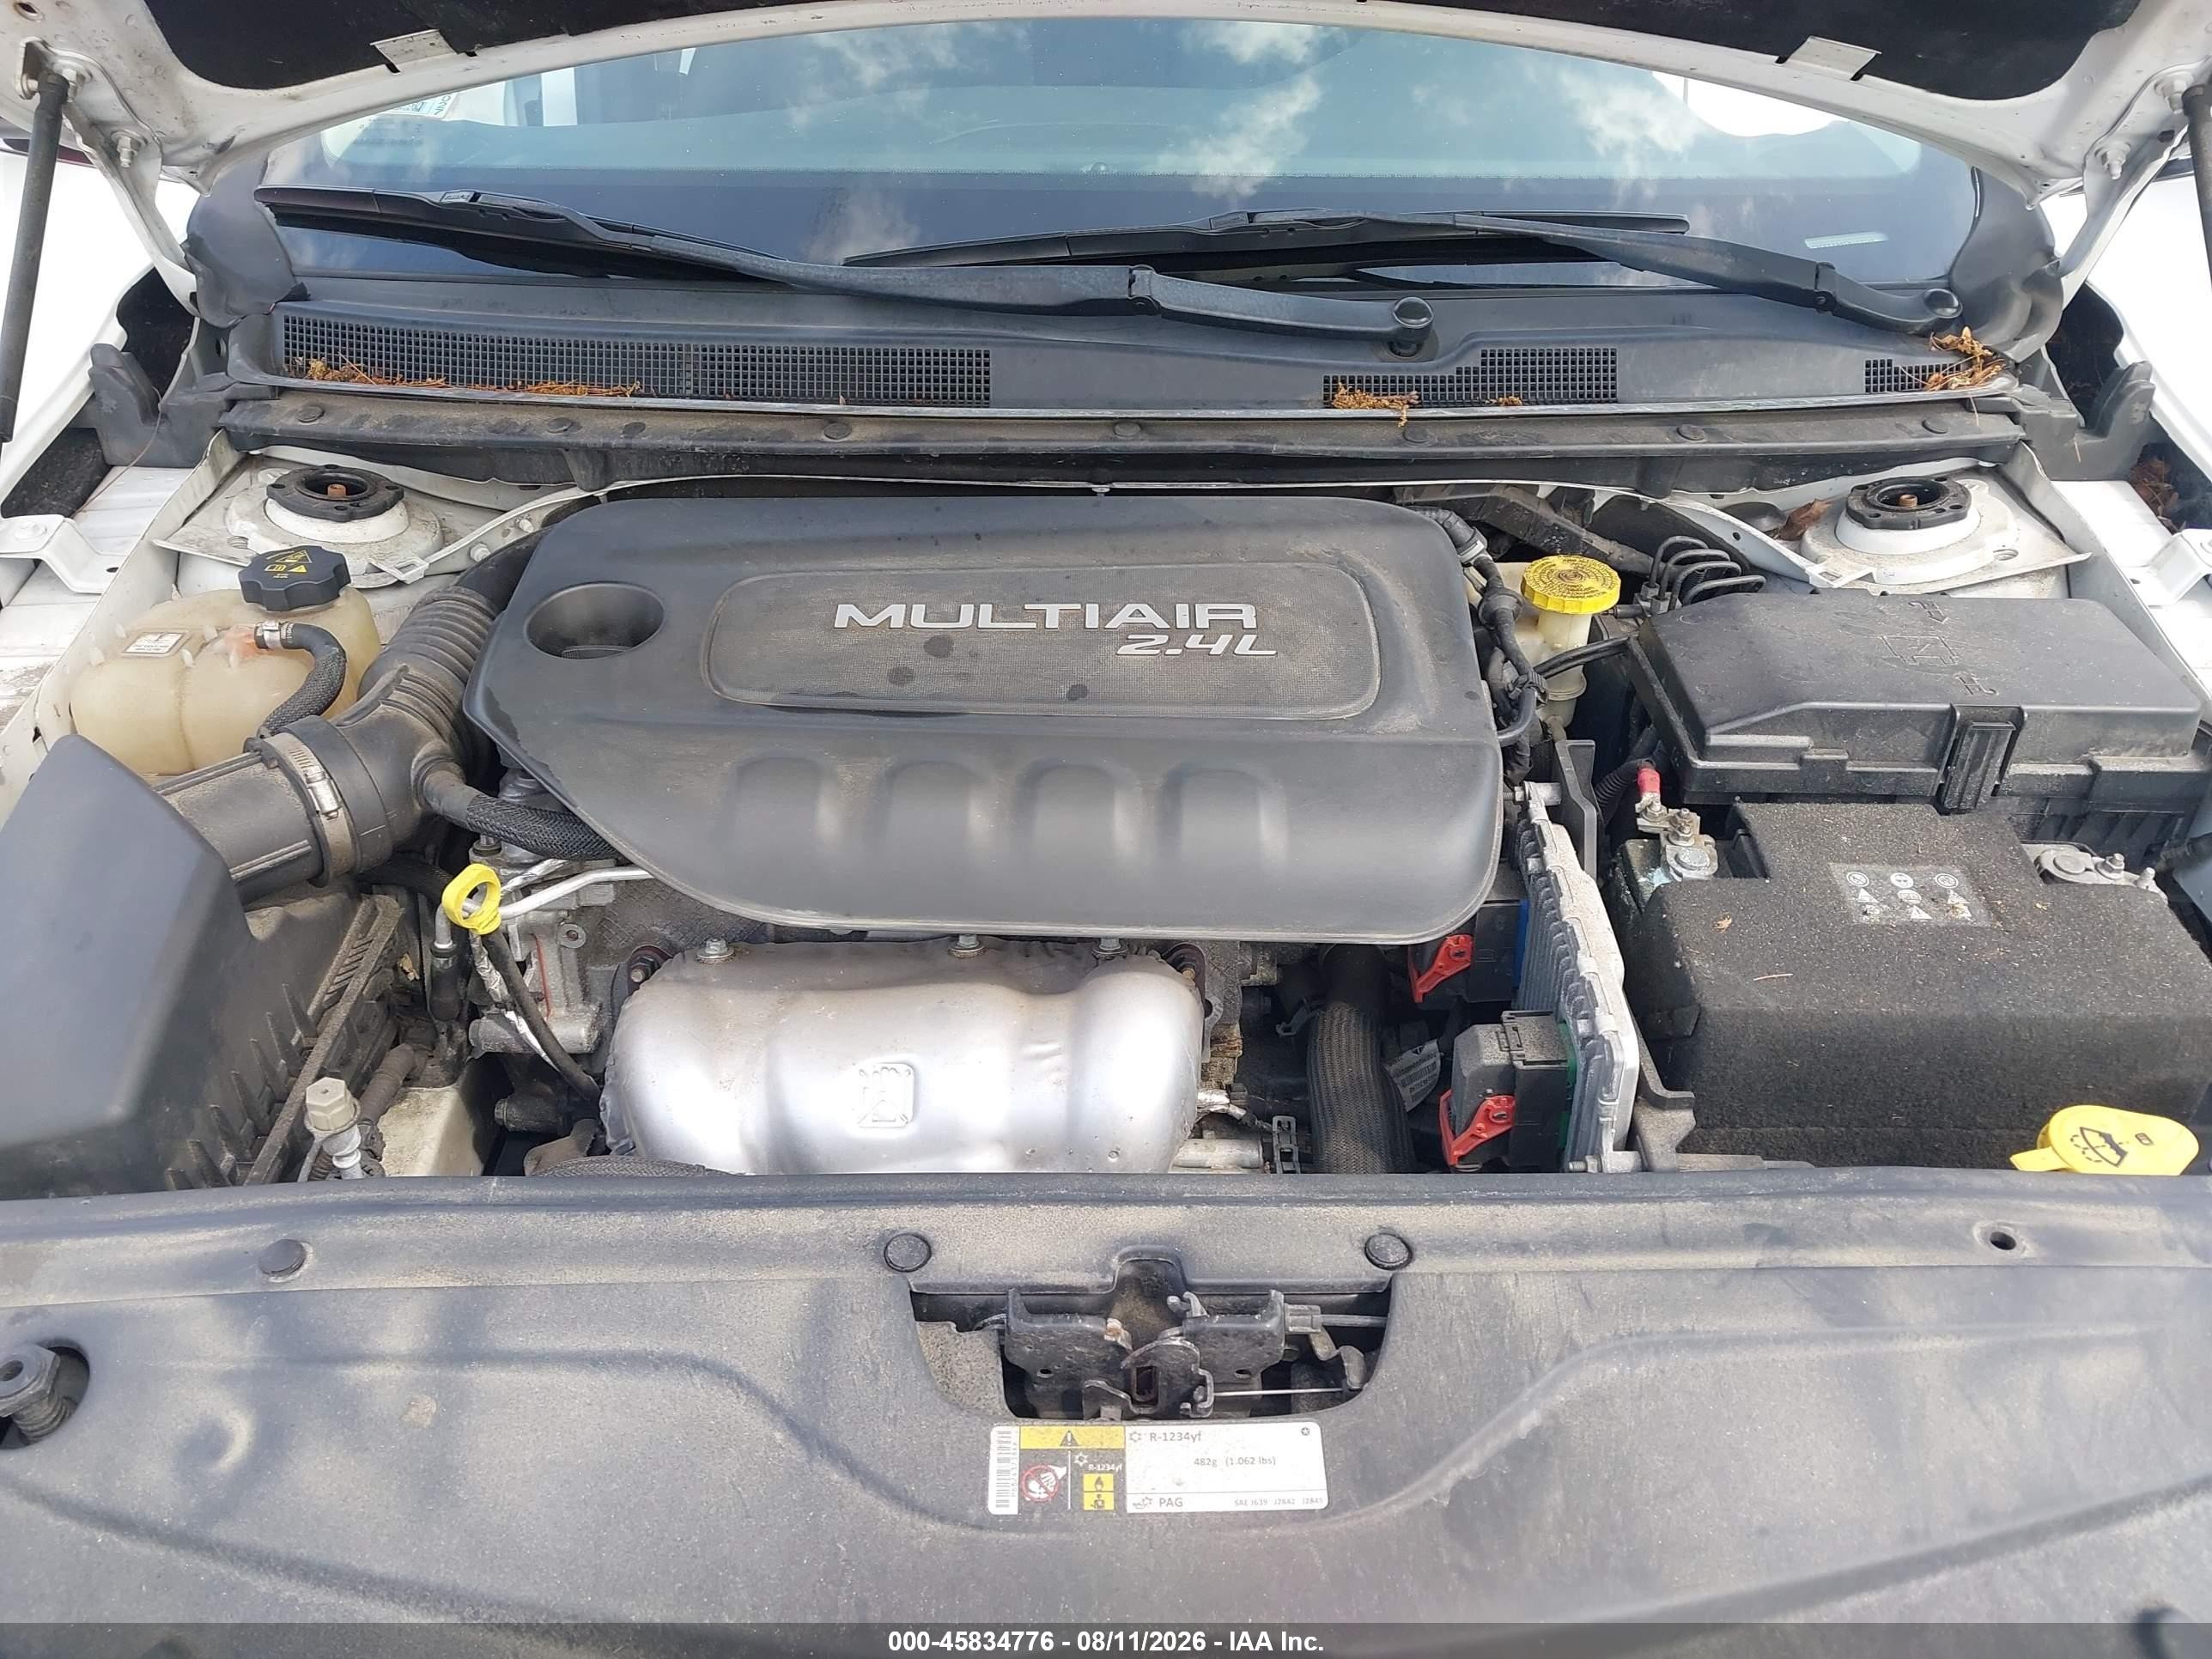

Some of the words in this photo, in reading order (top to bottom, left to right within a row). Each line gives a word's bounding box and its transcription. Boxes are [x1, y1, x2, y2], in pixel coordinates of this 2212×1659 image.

[833, 603, 1258, 629] MULTIAIR
[1115, 634, 1278, 656] 2.4L
[1150, 1430, 1202, 1443] R-1234yf
[1088, 1463, 1122, 1473] R-1234yf
[1194, 1457, 1218, 1468] 482g
[1225, 1455, 1255, 1468] (1.062
[1258, 1455, 1277, 1467] lbs)
[1158, 1497, 1183, 1508] PAG
